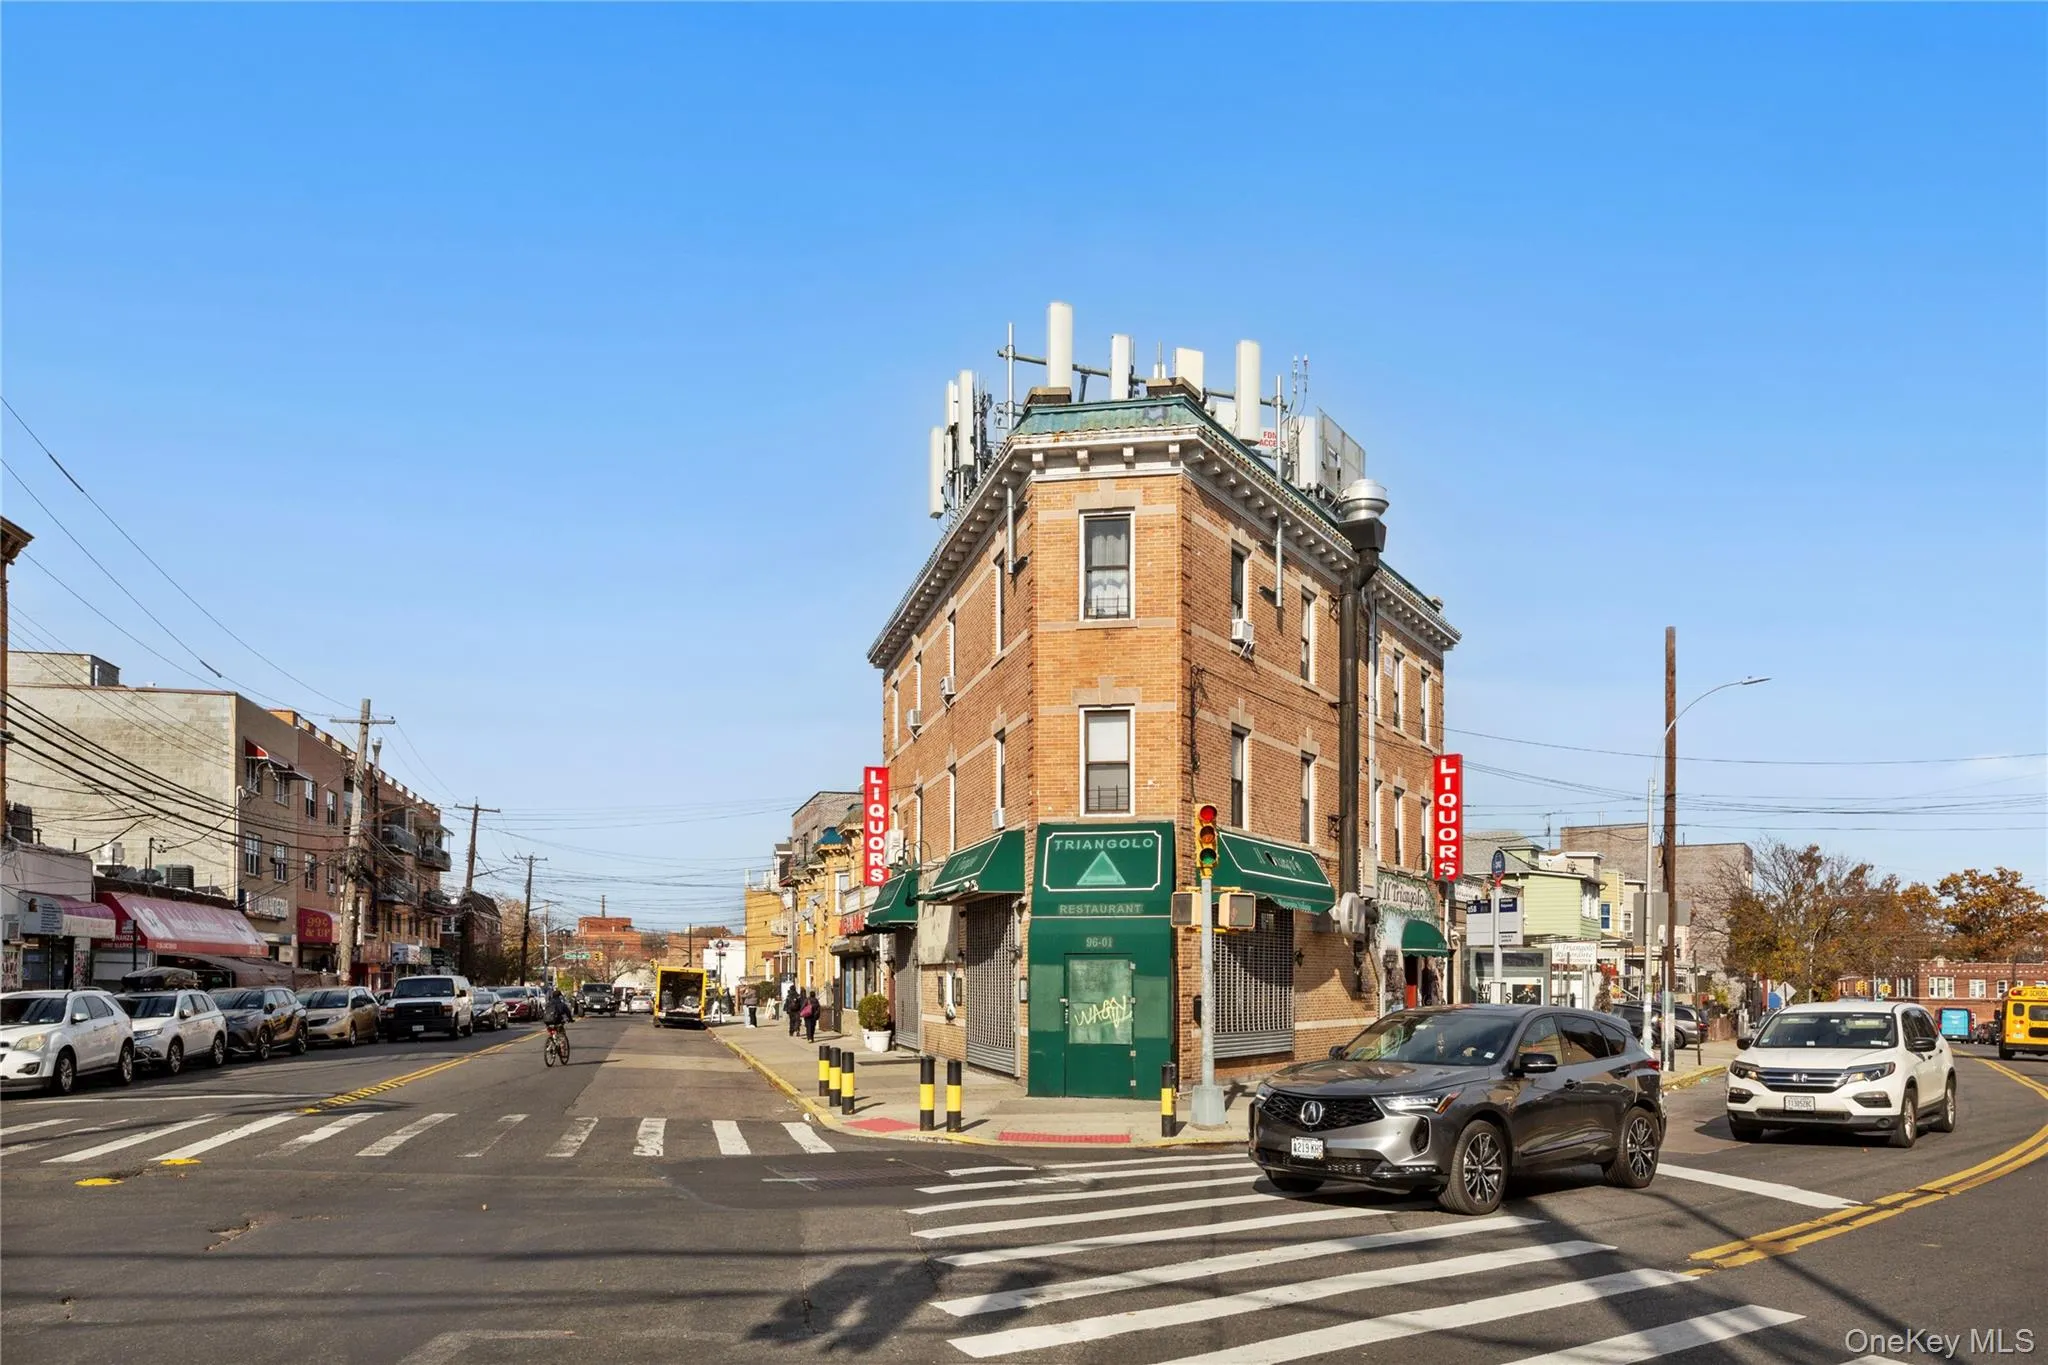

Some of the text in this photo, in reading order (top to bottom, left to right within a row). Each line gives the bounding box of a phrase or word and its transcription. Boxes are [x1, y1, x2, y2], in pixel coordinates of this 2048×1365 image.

[1259, 440, 1287, 448] ACCES
[1438, 758, 1457, 876] LIQUORS
[868, 769, 885, 883] LIQUORS
[1054, 838, 1154, 850] TRIANGOLO
[1059, 903, 1141, 915] RESTAURANT
[305, 929, 330, 937] & UP
[1085, 937, 1113, 948] 96-01
